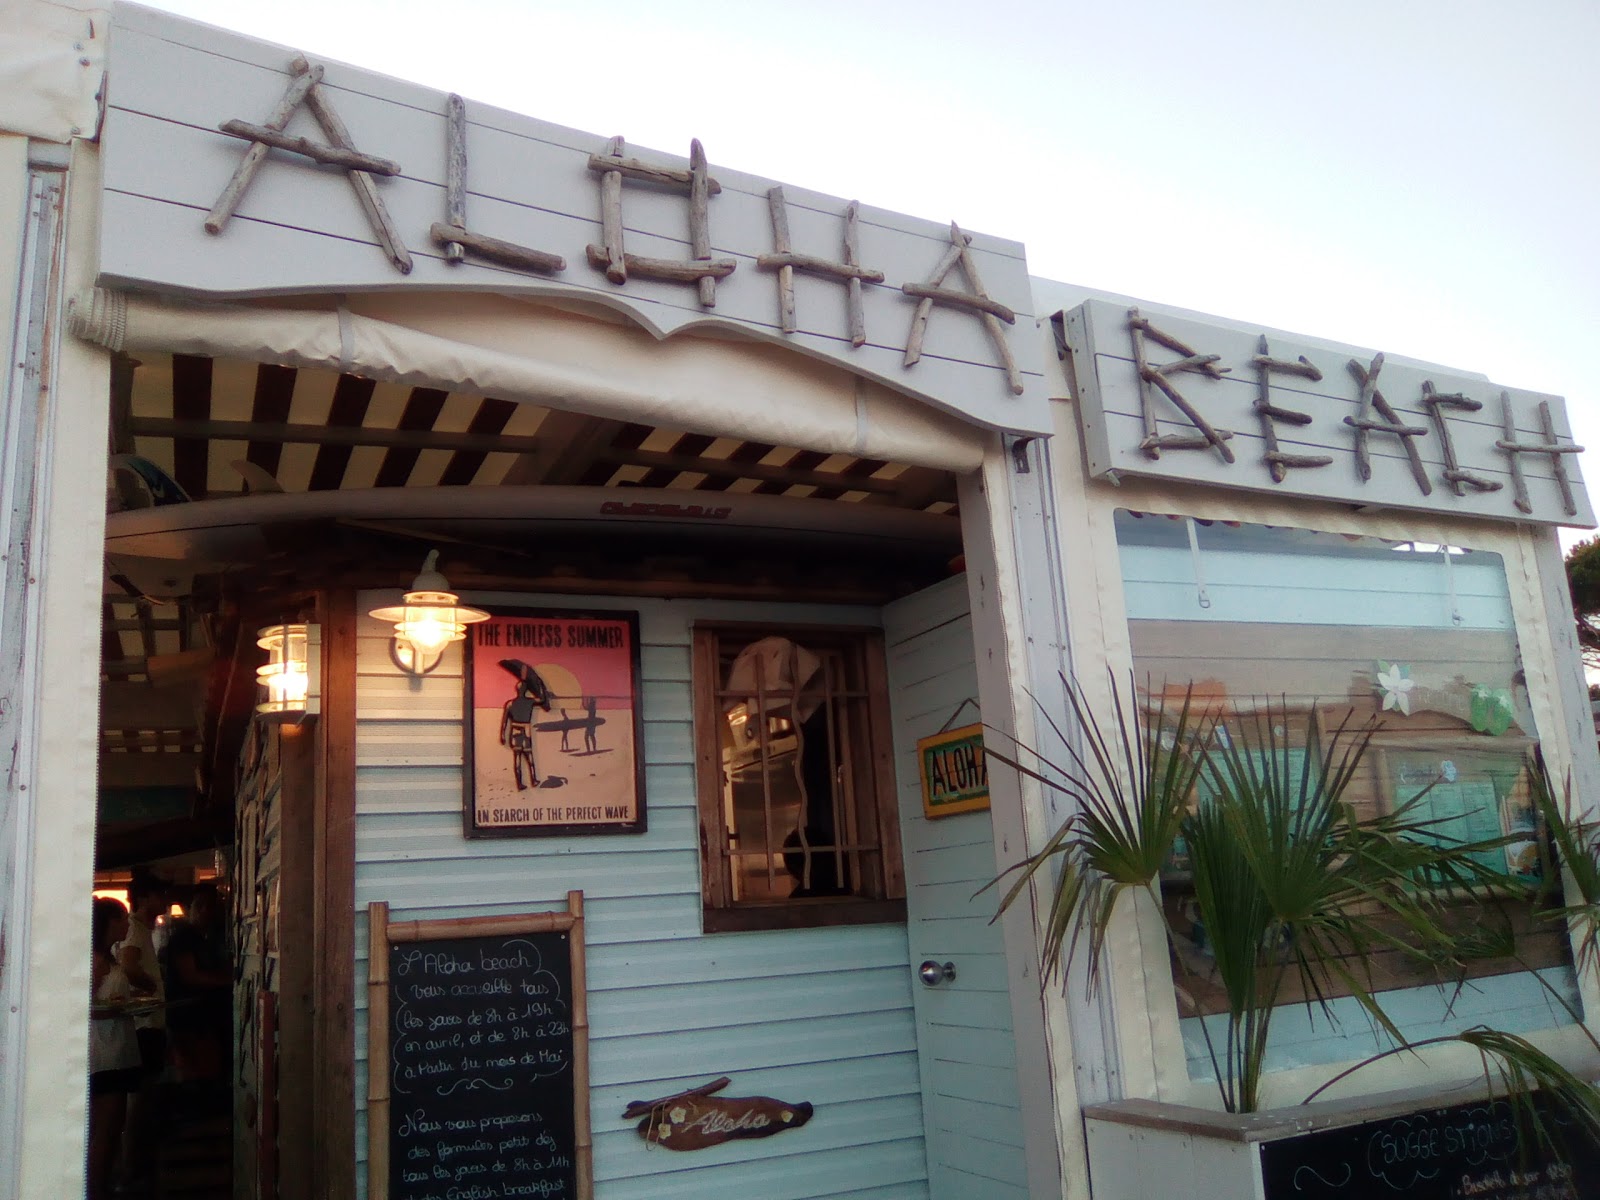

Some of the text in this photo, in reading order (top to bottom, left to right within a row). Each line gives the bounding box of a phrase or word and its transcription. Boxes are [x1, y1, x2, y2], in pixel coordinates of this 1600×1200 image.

[204, 53, 1024, 396] ALOHA
[478, 622, 624, 649] THE ENDLESS SUMMER
[477, 805, 629, 823] IN SEARCH OF THE PERFECT WAVE
[480, 949, 532, 971] beach
[519, 979, 550, 996] tous
[403, 1010, 424, 1029] les
[467, 1010, 482, 1026] de
[485, 1008, 502, 1023] 8h
[507, 1008, 518, 1021] à
[522, 1002, 553, 1019] 19h
[469, 1031, 485, 1045] et
[487, 1031, 507, 1043] de
[511, 1027, 530, 1041] 8h
[535, 1025, 547, 1038] à
[547, 1022, 570, 1036] 23h
[404, 1065, 417, 1079] à
[520, 1052, 536, 1065] de
[398, 1108, 442, 1137] Nous
[444, 1119, 477, 1131] vous
[681, 1108, 770, 1134] Aloha
[407, 1146, 431, 1160] des
[436, 1139, 494, 1161] formules
[402, 1169, 429, 1183] tous
[491, 1160, 507, 1173] de
[513, 1157, 530, 1171] 8h
[532, 1159, 544, 1170] à
[502, 1178, 564, 1199] breakfast
